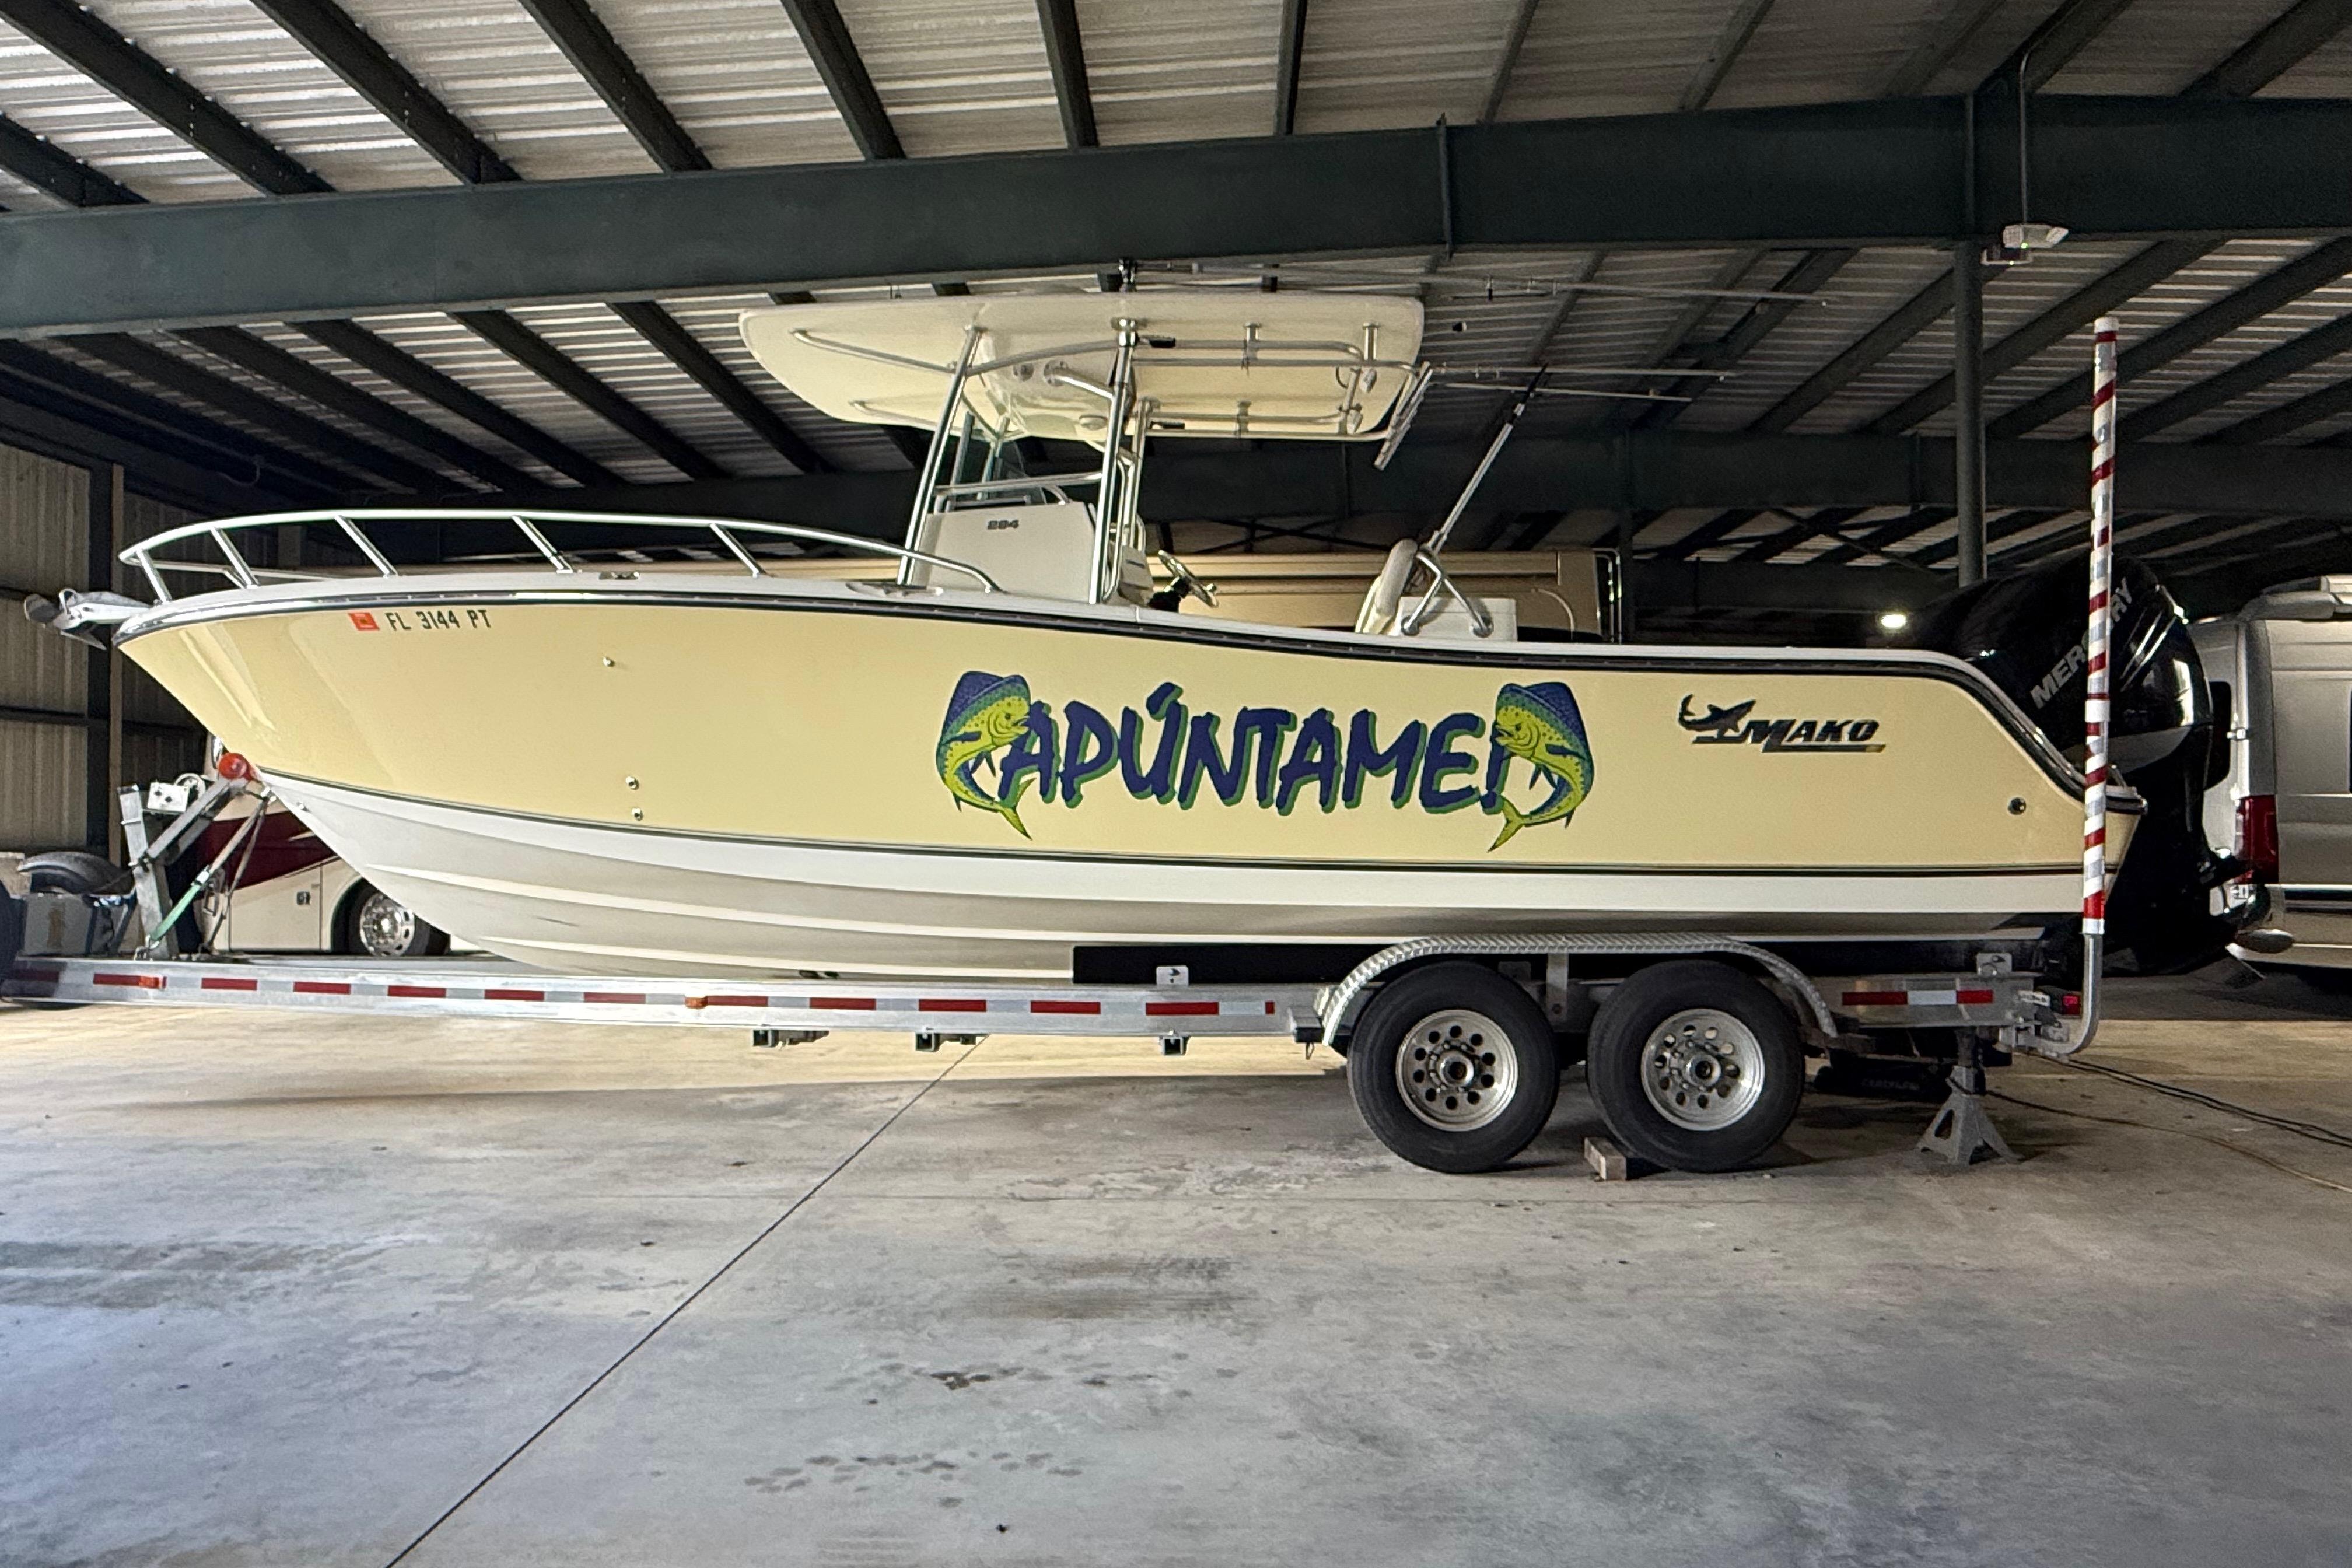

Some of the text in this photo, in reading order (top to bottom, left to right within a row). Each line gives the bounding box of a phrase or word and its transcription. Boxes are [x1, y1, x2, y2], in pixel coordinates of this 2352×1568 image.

[385, 609, 491, 631] FL 3144 PT
[2030, 576, 2133, 710] MERRY
[1743, 719, 1880, 752] MAKO
